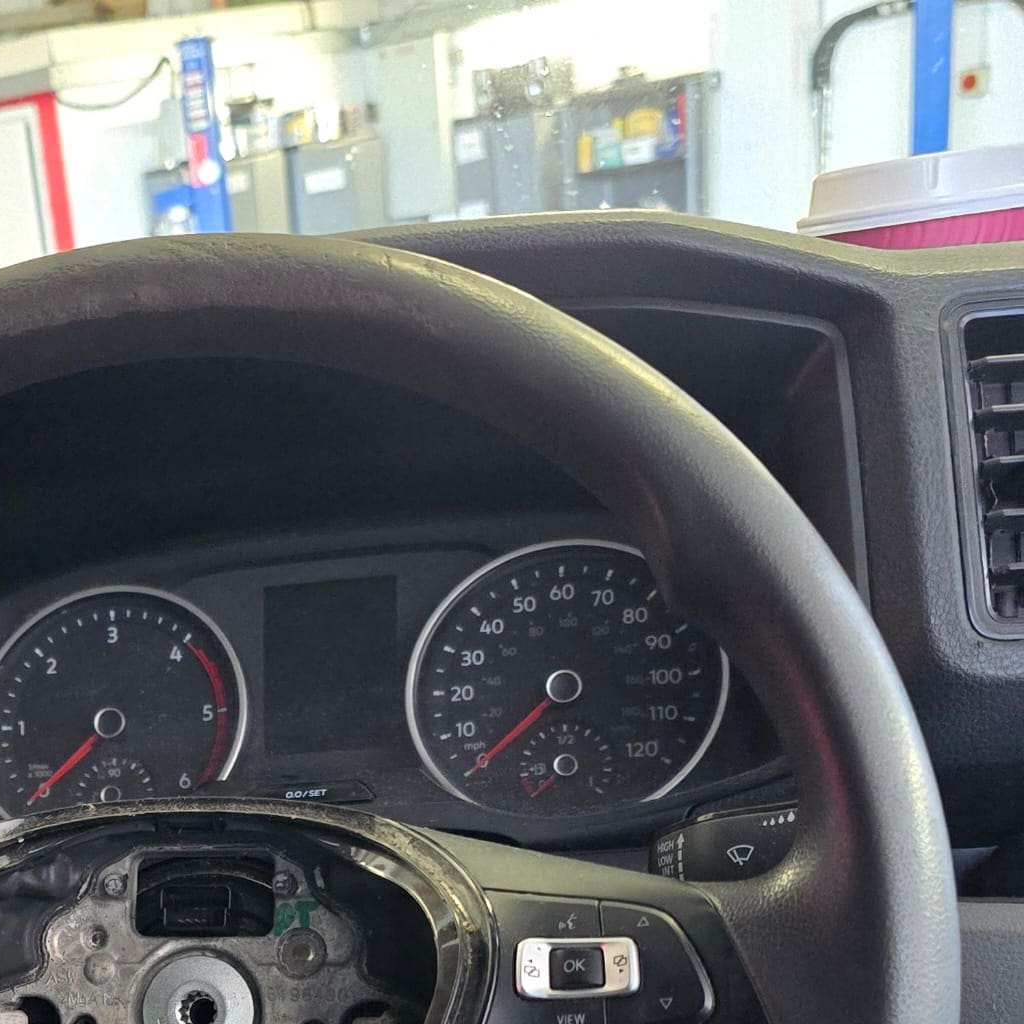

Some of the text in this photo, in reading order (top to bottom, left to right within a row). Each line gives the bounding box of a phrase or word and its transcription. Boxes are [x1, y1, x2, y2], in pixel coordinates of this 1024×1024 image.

[550, 584, 575, 601] 60
[591, 589, 614, 607] 70
[512, 597, 536, 613] 50
[622, 607, 648, 624] 80
[480, 619, 504, 635] 40
[107, 627, 118, 644] 3
[645, 634, 671, 650] 90
[169, 646, 183, 663] 4
[460, 650, 485, 666] 30
[45, 658, 58, 675] 2
[649, 668, 682, 685] 100
[451, 686, 474, 702] 20
[202, 705, 213, 721] 5
[649, 705, 678, 721] 110
[17, 721, 25, 736] 1
[456, 722, 476, 737] 10
[464, 740, 486, 752] mph
[557, 735, 575, 745] 1/2
[625, 740, 658, 758] 120
[108, 768, 121, 778] 90
[179, 773, 191, 789] 6
[657, 839, 675, 853] HIGH
[657, 854, 674, 867] LOW
[563, 958, 586, 972] OK
